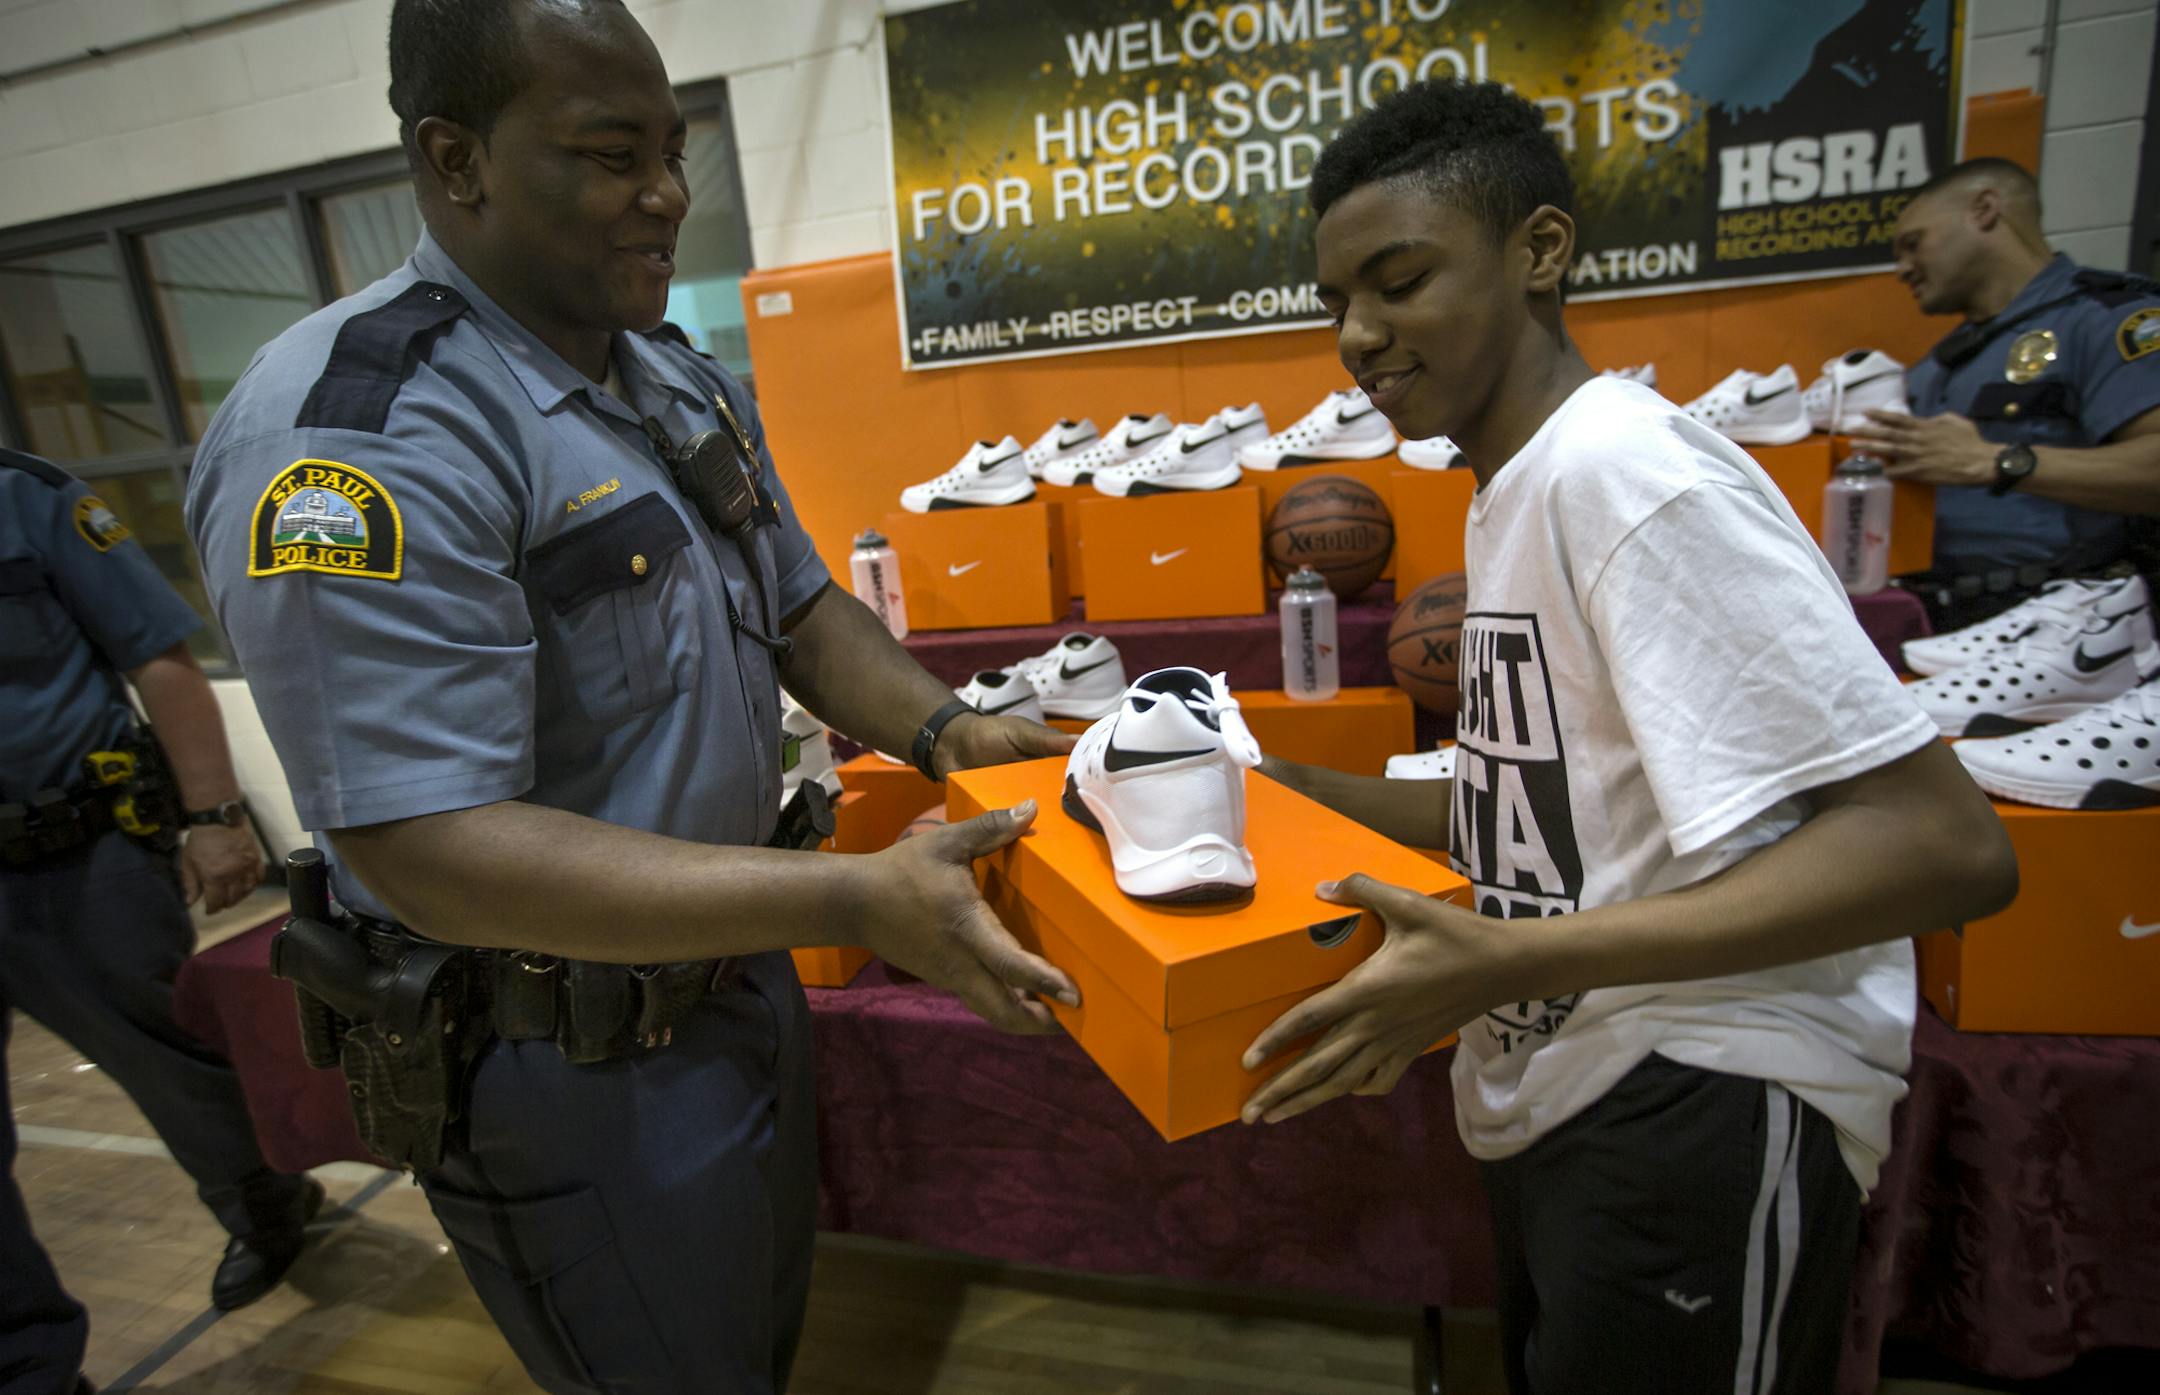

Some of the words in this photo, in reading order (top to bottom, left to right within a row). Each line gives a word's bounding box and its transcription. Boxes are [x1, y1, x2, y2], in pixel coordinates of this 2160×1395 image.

[1066, 0, 1349, 79] WELCOME
[912, 177, 1033, 241] FOR
[1053, 129, 1340, 222] RECORD
[1540, 78, 1681, 152] RTS
[1035, 91, 1188, 164] HIGH
[1718, 122, 1931, 210] HSRA
[1716, 226, 1858, 262] RECORDING
[1864, 221, 1897, 245] AR
[1717, 209, 1776, 237] HIGH
[1779, 200, 1873, 231] SCHOOL
[1880, 195, 1908, 219] FO
[922, 316, 1030, 355] FAMILY
[1050, 296, 1199, 339] RESPECT
[1569, 241, 1698, 286] ATION
[271, 475, 302, 508] ST.
[303, 467, 375, 510] PAUL
[272, 545, 368, 569] POLICE
